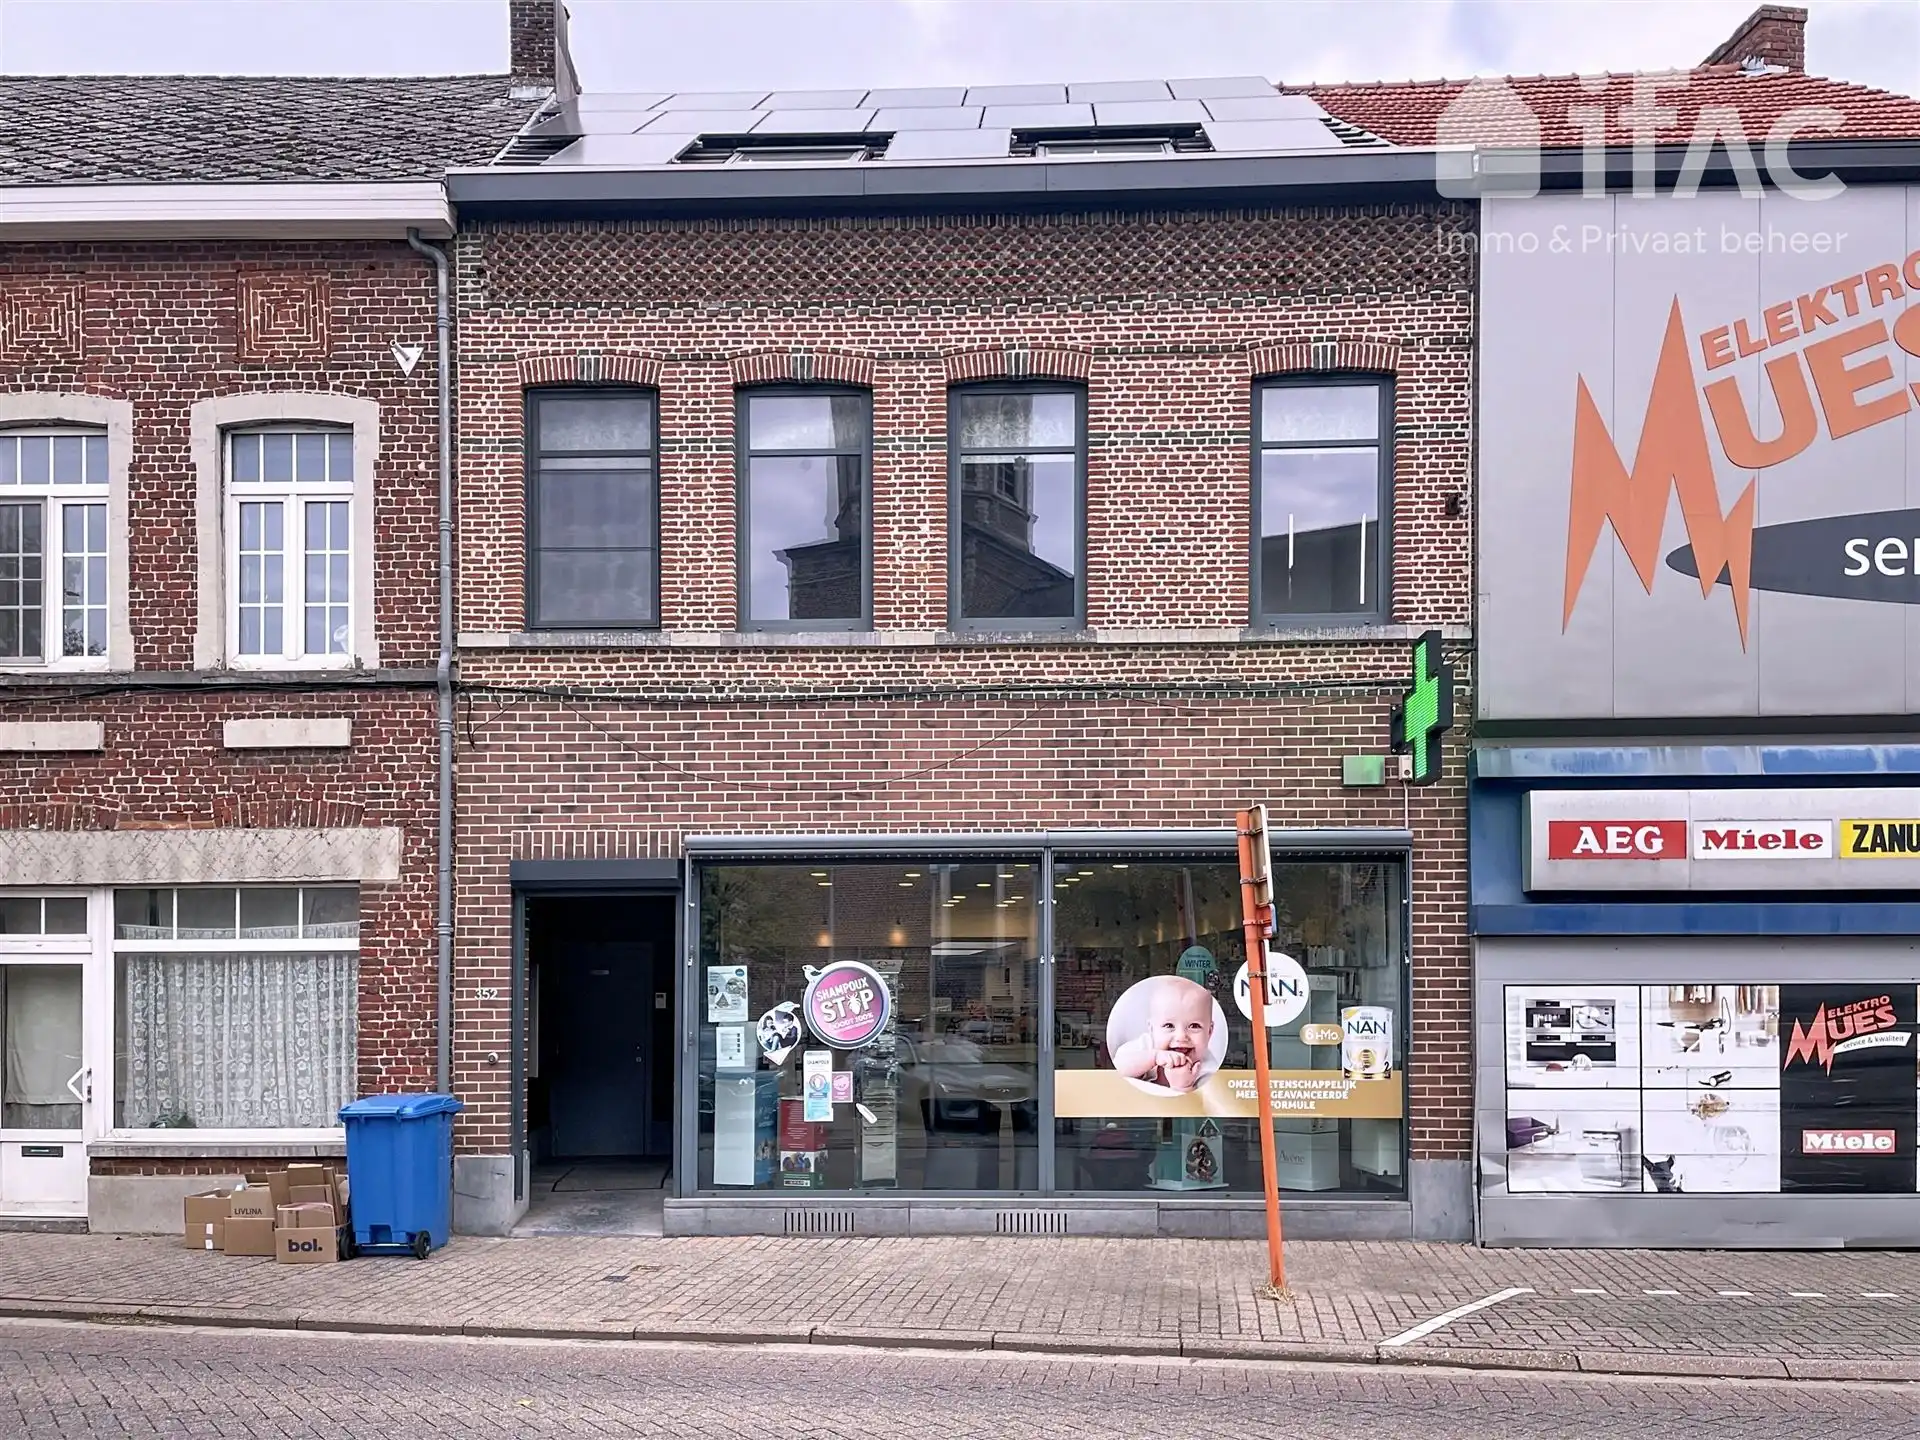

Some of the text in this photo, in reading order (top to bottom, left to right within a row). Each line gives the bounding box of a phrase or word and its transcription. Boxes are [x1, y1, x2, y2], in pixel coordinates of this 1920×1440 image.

[1572, 826, 1664, 854] AEG
[1702, 829, 1824, 850] Miele
[1852, 824, 1920, 852] ZANU
[1185, 960, 1210, 968] WINTER
[474, 987, 498, 1000] 352
[815, 977, 868, 1001] SHAMPOUX
[1828, 996, 1890, 1019] ELEKTRO
[1305, 1029, 1313, 1040] 6
[1348, 1021, 1386, 1034] NAN
[1784, 1002, 1897, 1076] MUES
[1843, 1038, 1865, 1049] service
[1875, 1034, 1904, 1043] kwaliteit
[1228, 1080, 1256, 1089] ONZE
[1236, 1090, 1348, 1099] MEE GEAVANCEERDE
[1806, 1133, 1892, 1149] Miele
[288, 1239, 323, 1252] bol.
